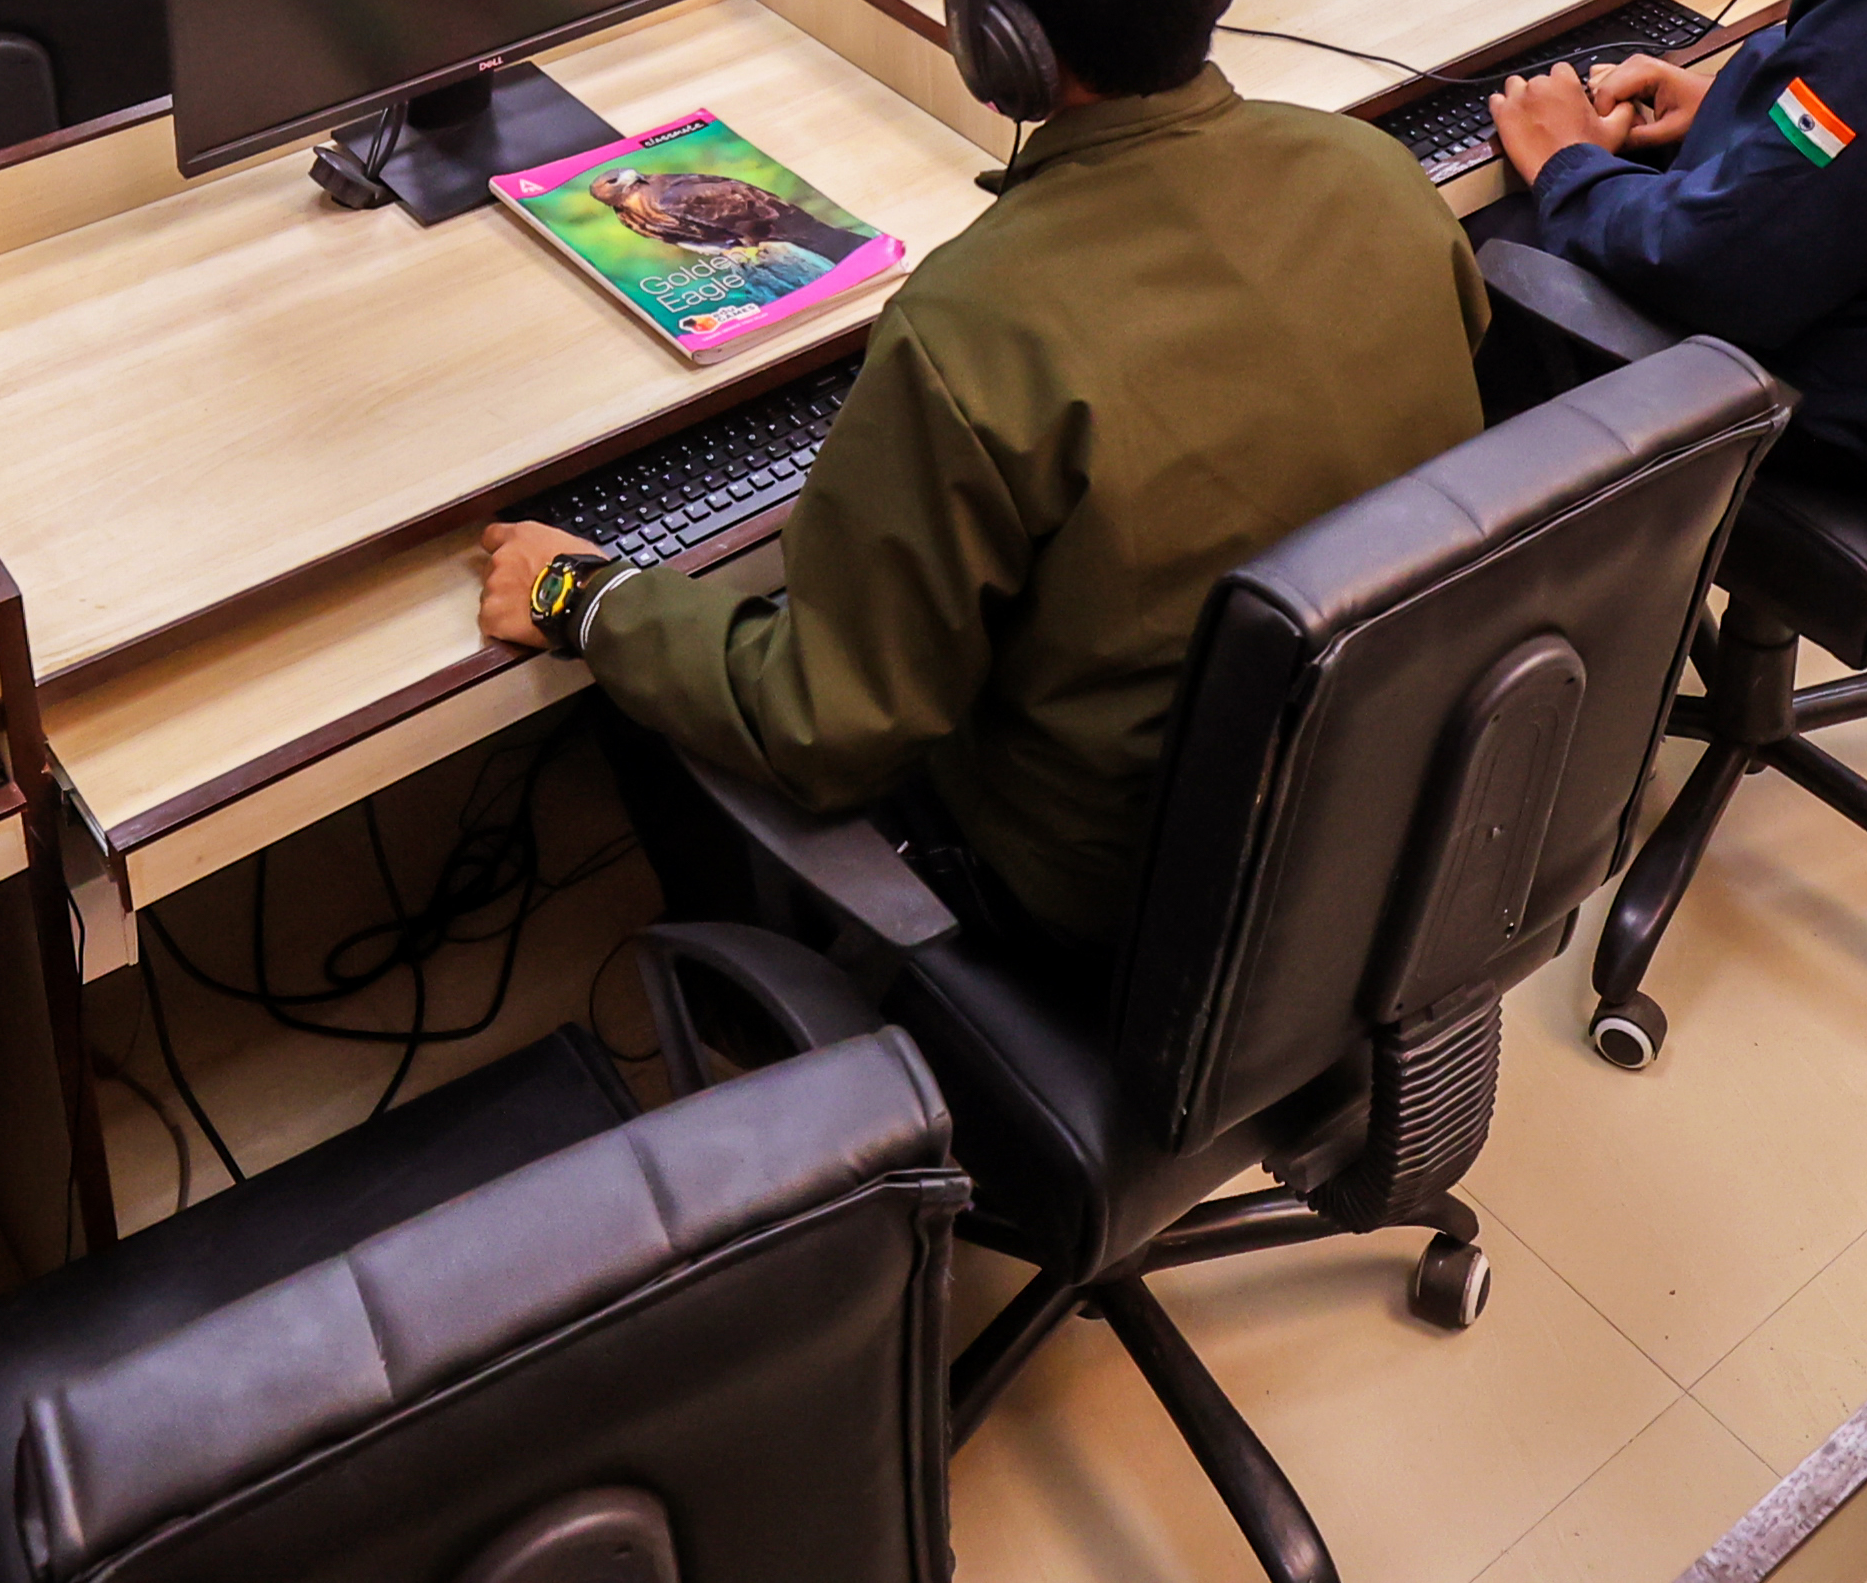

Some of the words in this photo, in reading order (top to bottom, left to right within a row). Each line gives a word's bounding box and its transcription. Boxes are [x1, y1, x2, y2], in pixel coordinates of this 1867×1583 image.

[479, 56, 504, 72] DELL
[639, 250, 750, 296] Golden
[656, 273, 746, 314] Eagle
